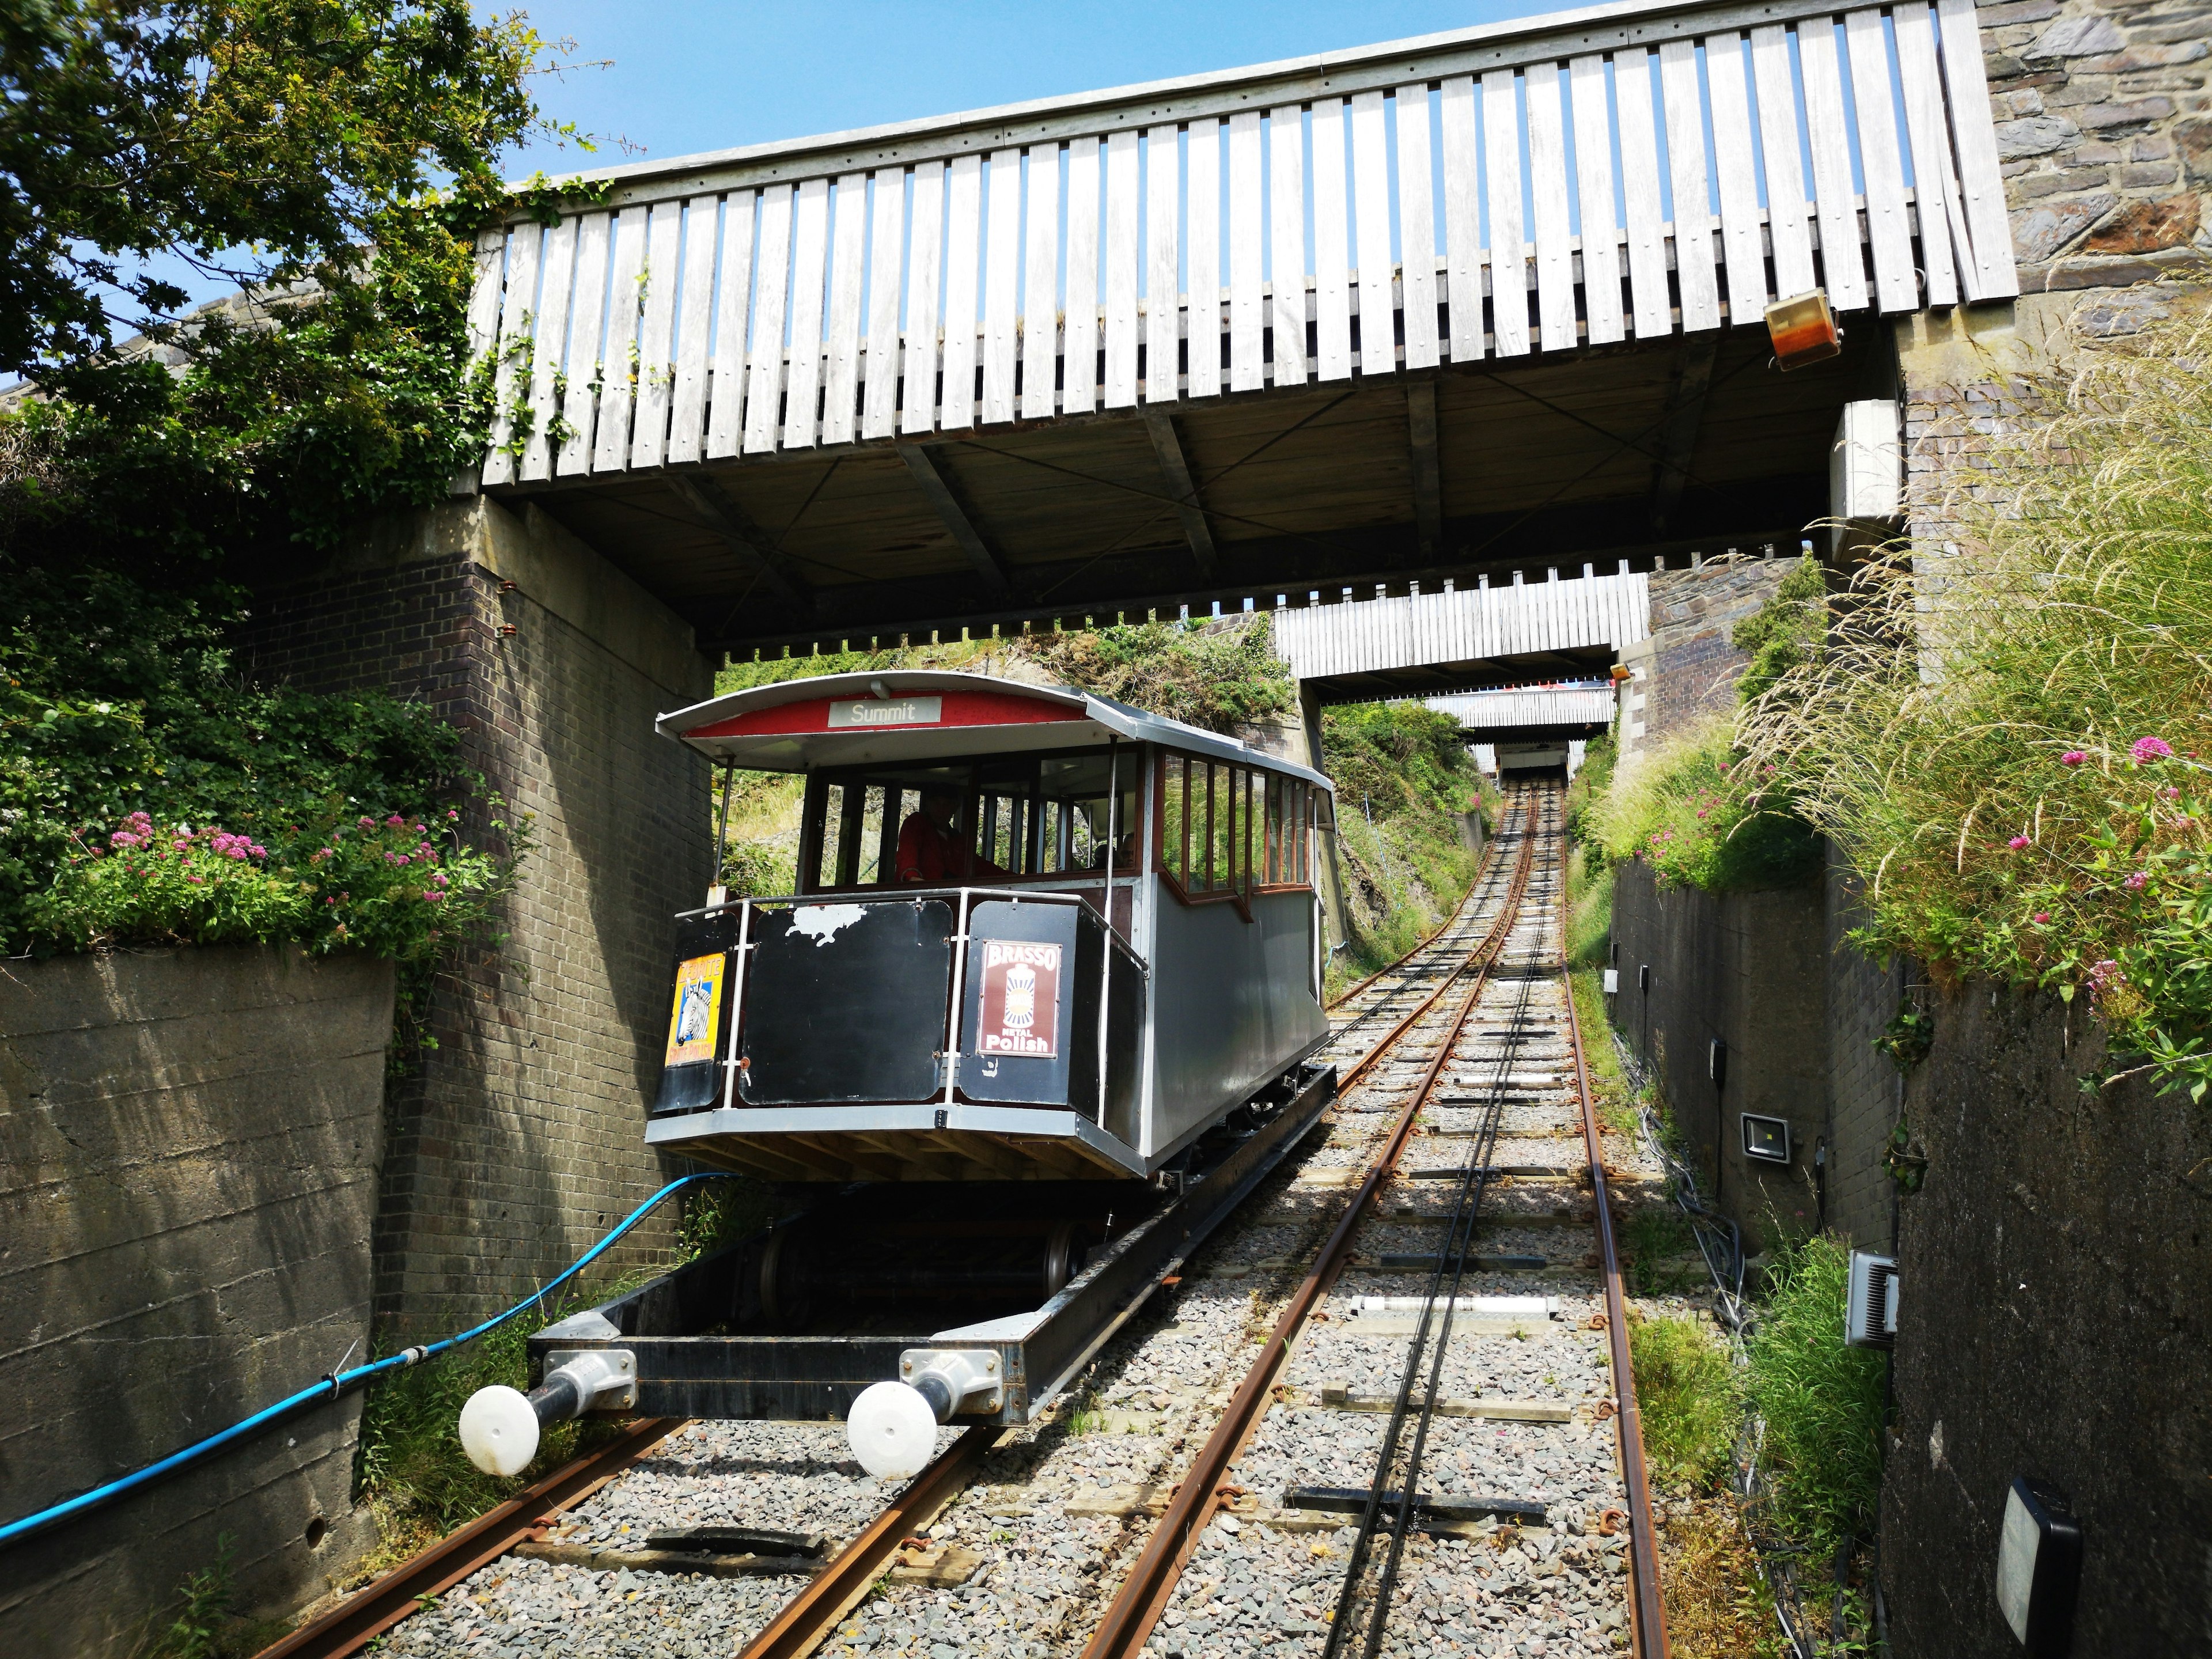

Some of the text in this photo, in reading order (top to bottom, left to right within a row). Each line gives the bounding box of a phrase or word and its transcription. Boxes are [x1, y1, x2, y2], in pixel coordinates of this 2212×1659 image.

[851, 702, 915, 723] Summit
[987, 944, 1057, 972] BRASSO
[679, 957, 722, 983] ZEBRITE
[1002, 1028, 1033, 1037] METAL
[986, 1035, 1048, 1052] Polish
